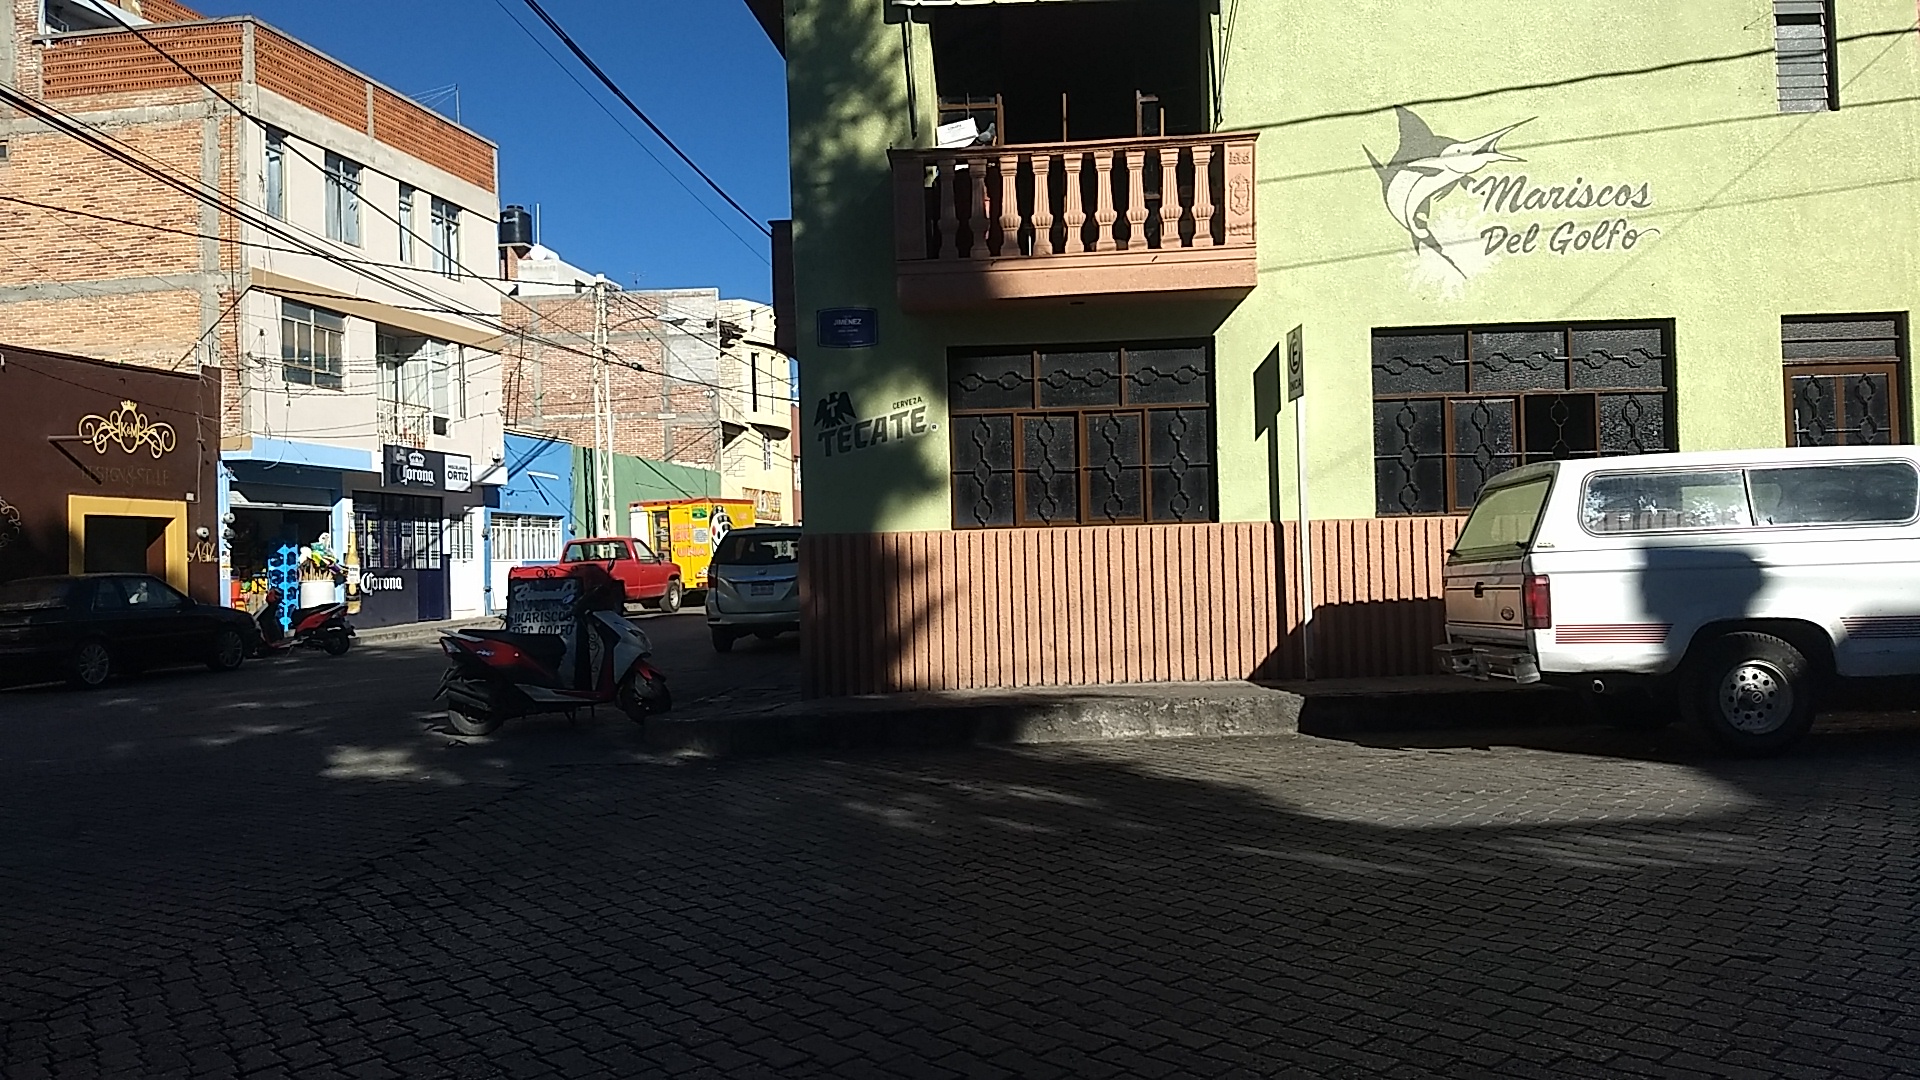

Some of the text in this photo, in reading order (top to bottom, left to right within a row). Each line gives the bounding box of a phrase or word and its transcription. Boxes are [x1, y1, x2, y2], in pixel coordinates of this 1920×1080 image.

[1473, 174, 1652, 213] Mariscos
[1480, 217, 1661, 256] Del Golfo
[892, 396, 923, 410] CERVEZA
[817, 406, 928, 457] TECATE
[396, 464, 436, 486] Corona
[447, 470, 469, 482] ORTIZ
[360, 572, 403, 596] Corona
